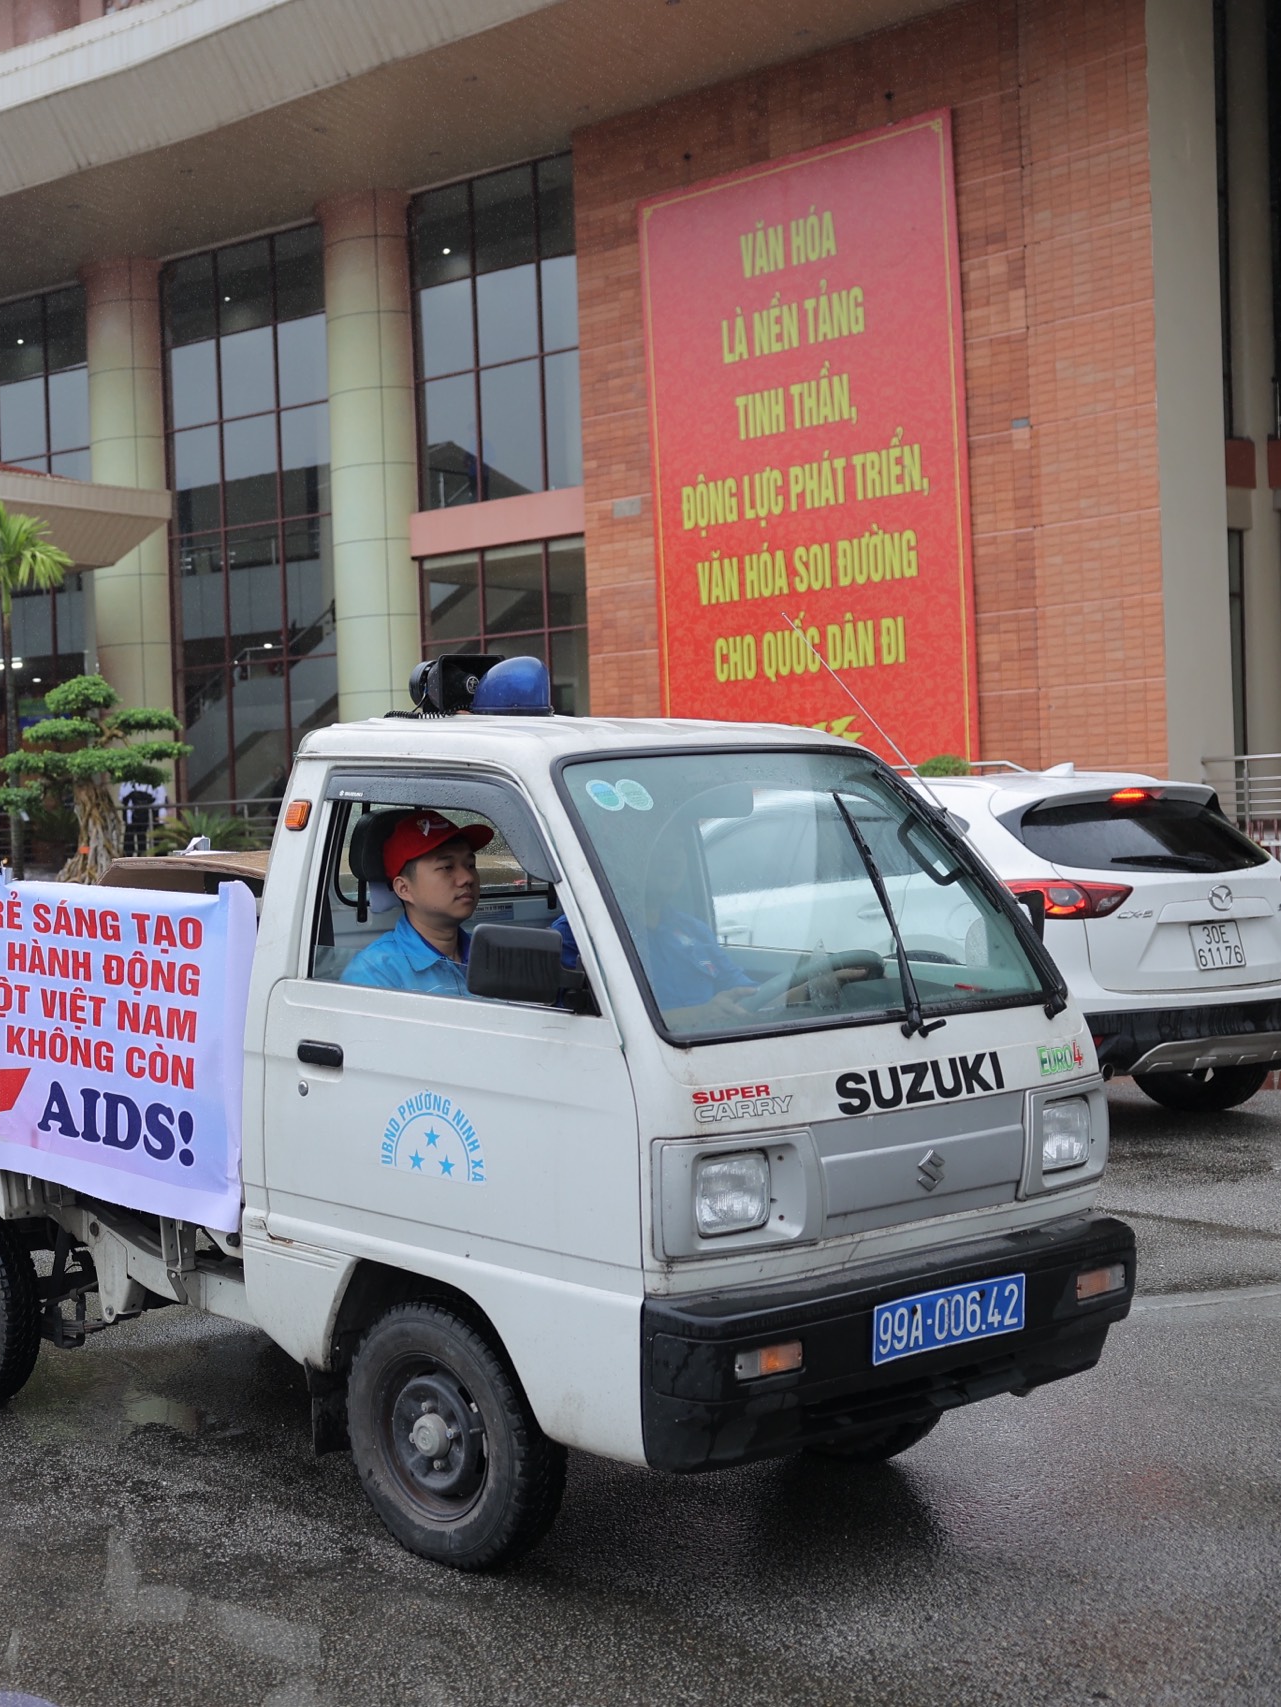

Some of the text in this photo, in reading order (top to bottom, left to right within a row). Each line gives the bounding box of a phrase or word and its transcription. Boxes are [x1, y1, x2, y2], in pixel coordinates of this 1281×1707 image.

[739, 204, 838, 279] VĂN HÓA
[722, 278, 865, 364] LÀ NỀN TẢNG
[735, 360, 857, 441] TINH THẦN,
[681, 426, 930, 538] ĐỘNG LỰC PHÁT TRIỂN,
[696, 523, 919, 606] VĂN HÓA SOI ĐƯỜNG
[714, 611, 907, 683] CHO QUỐC DÂN ĐI
[33, 899, 121, 942] SÁNG
[131, 912, 204, 954] TẠO
[1197, 944, 1244, 968] 611.76
[1202, 924, 1230, 945] 30E
[7, 938, 201, 997] HÀNH ĐỘNG
[40, 986, 107, 1031] VIỆT
[116, 999, 198, 1044] NAM
[6, 1024, 195, 1090] KHÔNG CÒN
[834, 1051, 1006, 1117] SUZUKI
[37, 1080, 195, 1167] AIDS!
[381, 1117, 401, 1165] UBND
[397, 1088, 452, 1122] PHƯỜNG
[452, 1108, 481, 1154] NINH
[691, 1084, 771, 1105] SUPER
[694, 1094, 793, 1123] CARRY
[878, 1283, 1020, 1355] 99A-006.42
